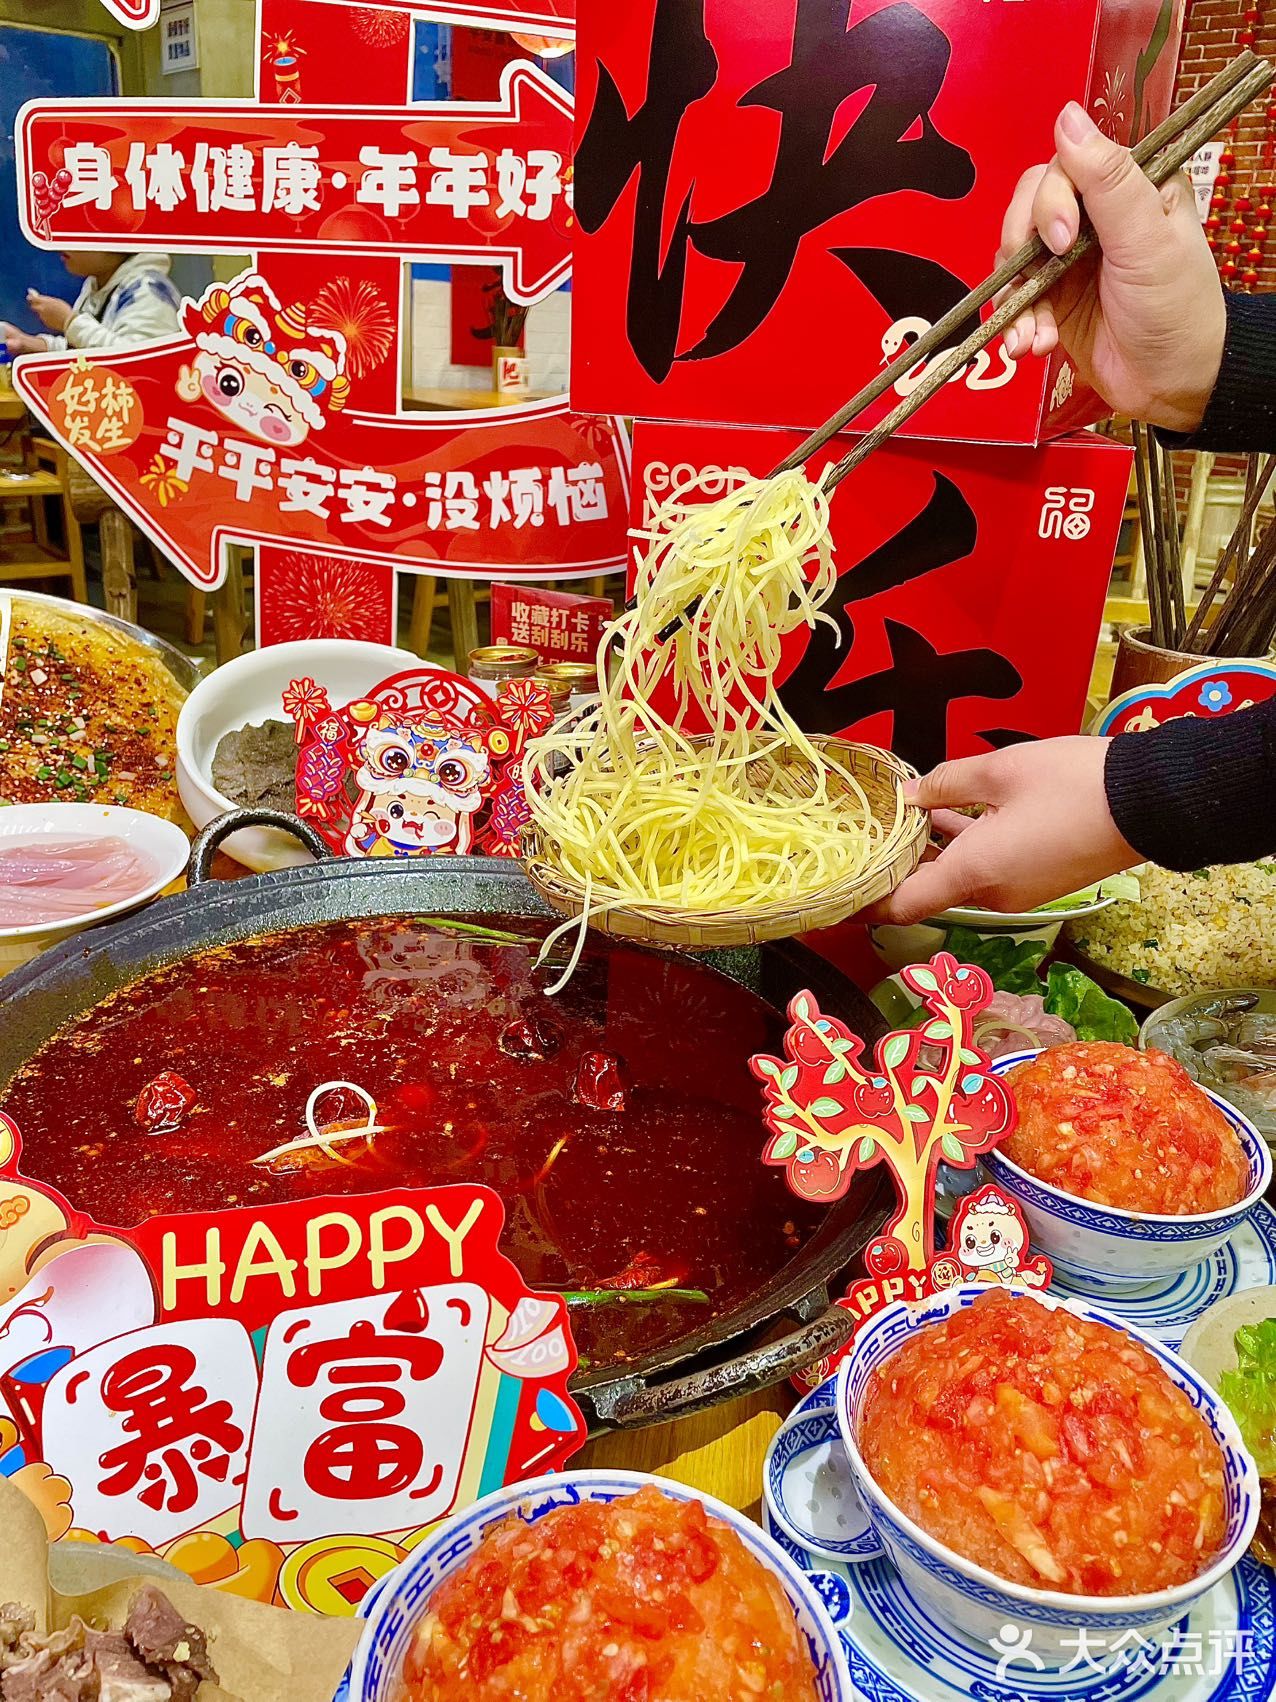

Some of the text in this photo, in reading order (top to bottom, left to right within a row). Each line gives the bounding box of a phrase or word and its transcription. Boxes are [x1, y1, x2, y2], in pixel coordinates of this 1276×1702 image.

[61, 140, 562, 221] 身体健康·年年好
[56, 374, 134, 424] 好柿
[64, 415, 133, 452] 发生
[158, 416, 608, 530] 平平安安·没烦恼
[511, 601, 590, 633] 收藏打卡
[511, 622, 589, 653] 送刮刮乐
[162, 1198, 485, 1311] HAPPY
[98, 1318, 445, 1513] 暴富
